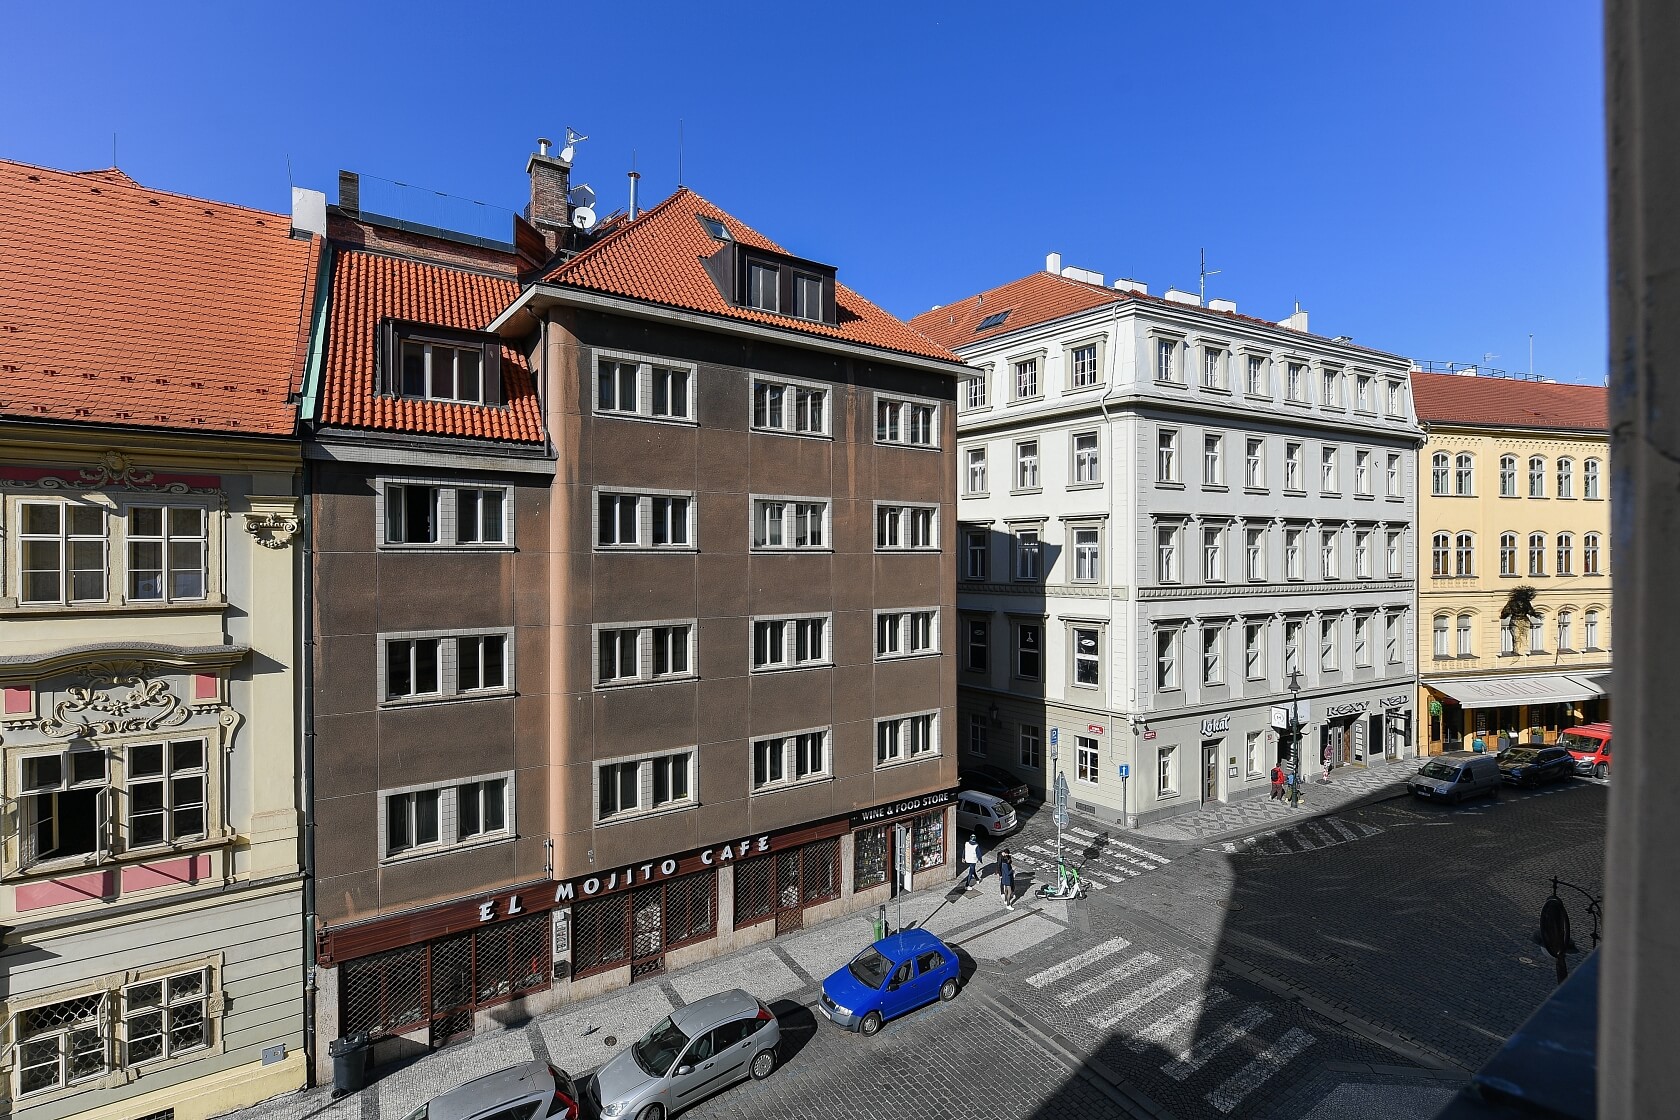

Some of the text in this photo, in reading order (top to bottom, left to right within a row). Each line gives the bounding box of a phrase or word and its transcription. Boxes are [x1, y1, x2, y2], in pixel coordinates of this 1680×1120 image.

[1326, 701, 1370, 717] ROXY
[861, 792, 949, 821] WINE & FOOD STORE
[479, 895, 522, 922] EL
[554, 859, 676, 903] MOJITO
